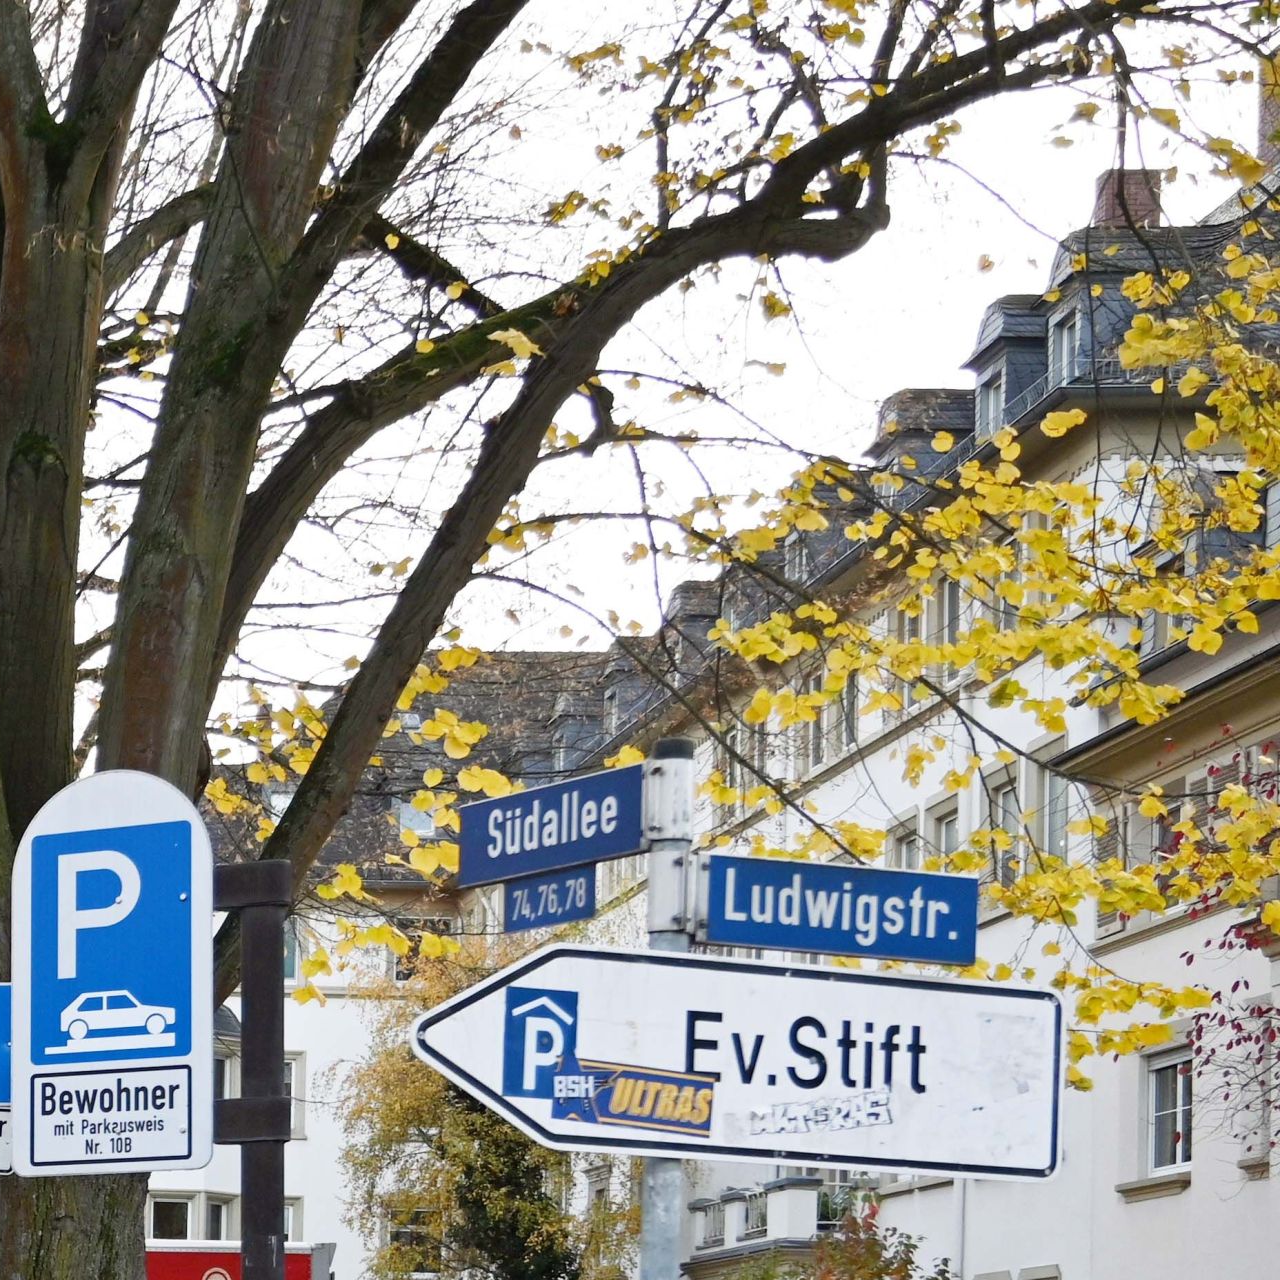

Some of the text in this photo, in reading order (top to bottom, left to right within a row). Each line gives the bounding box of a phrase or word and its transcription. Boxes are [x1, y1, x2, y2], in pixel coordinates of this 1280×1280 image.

[486, 789, 619, 859] Südallee
[57, 849, 142, 980] P
[724, 867, 959, 946] Ludwigstr.
[523, 1016, 564, 1090] P
[41, 1078, 180, 1116] Bewohner
[54, 1115, 165, 1136] mit Parkausweis
[553, 1075, 714, 1125] BSH ULTRAS
[85, 1137, 132, 1155] Nr. 10B
